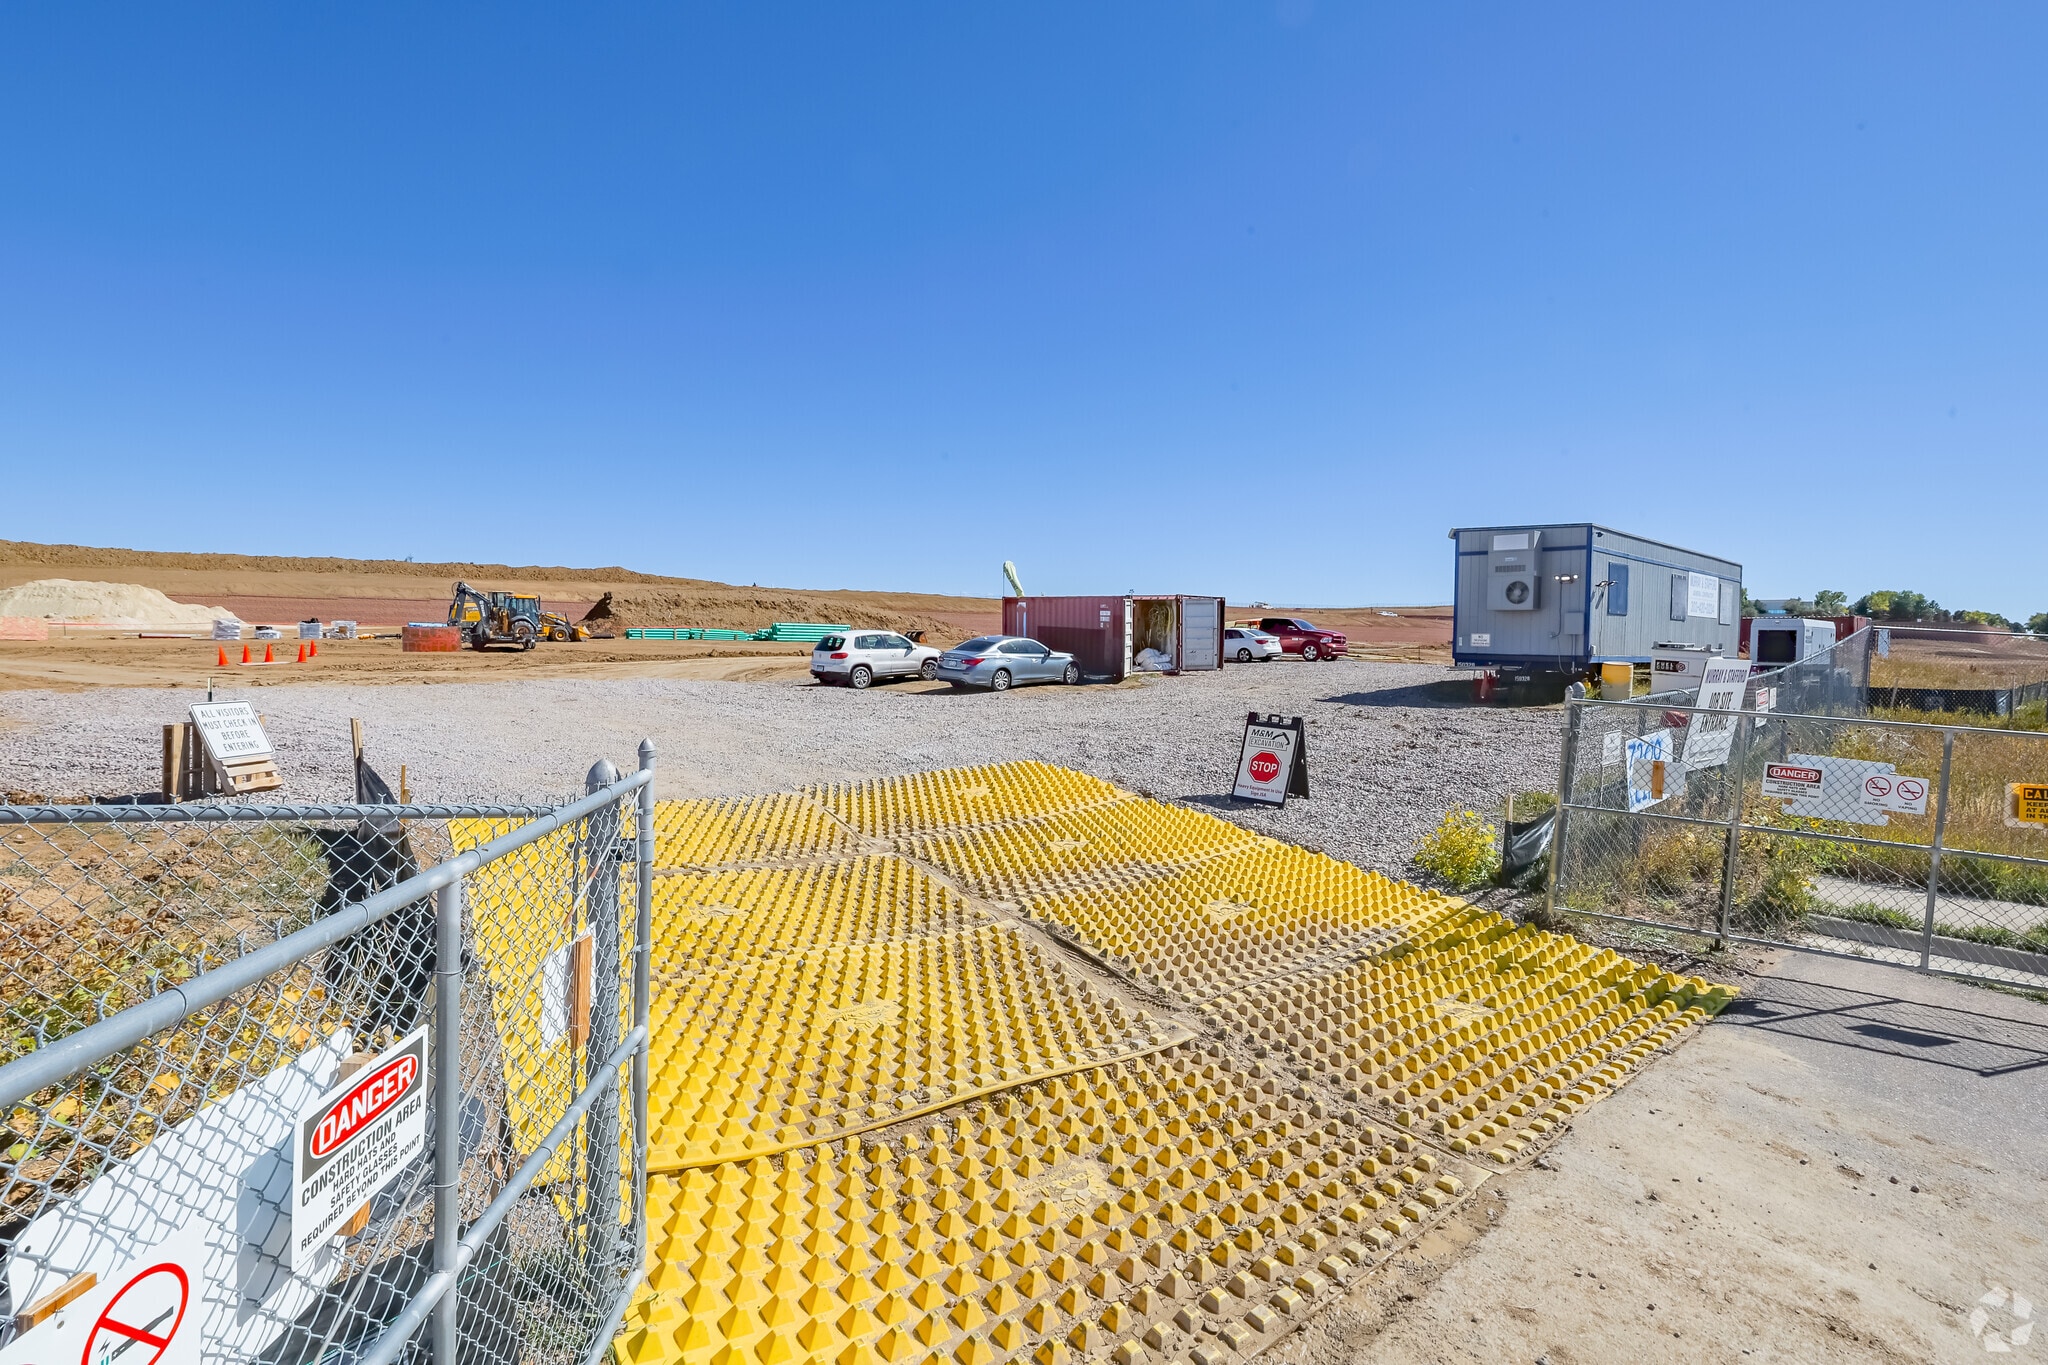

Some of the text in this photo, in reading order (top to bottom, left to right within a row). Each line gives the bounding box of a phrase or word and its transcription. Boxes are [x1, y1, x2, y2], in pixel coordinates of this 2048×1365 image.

[1709, 691, 1734, 709] JOB SITE
[200, 706, 250, 719] ALL VISITORS
[202, 717, 258, 730] MUST CHECK IN
[221, 729, 250, 740] BEFORE
[1251, 729, 1274, 738] M&M
[222, 740, 260, 752] ENTERING
[1251, 739, 1284, 748] EXCAVATION
[1251, 760, 1278, 774] STOP
[1772, 768, 1816, 781] DANGER
[1766, 779, 1805, 787] CONSTRUCTION
[318, 1057, 414, 1155] DANGER
[301, 1094, 422, 1208] CONSTRUCTION AREA
[332, 1131, 397, 1193] HARD HATS AND
[330, 1141, 398, 1209] SAFETY GLASSES
[300, 1133, 421, 1252] REQUIRED BEYOND THIS POINT
